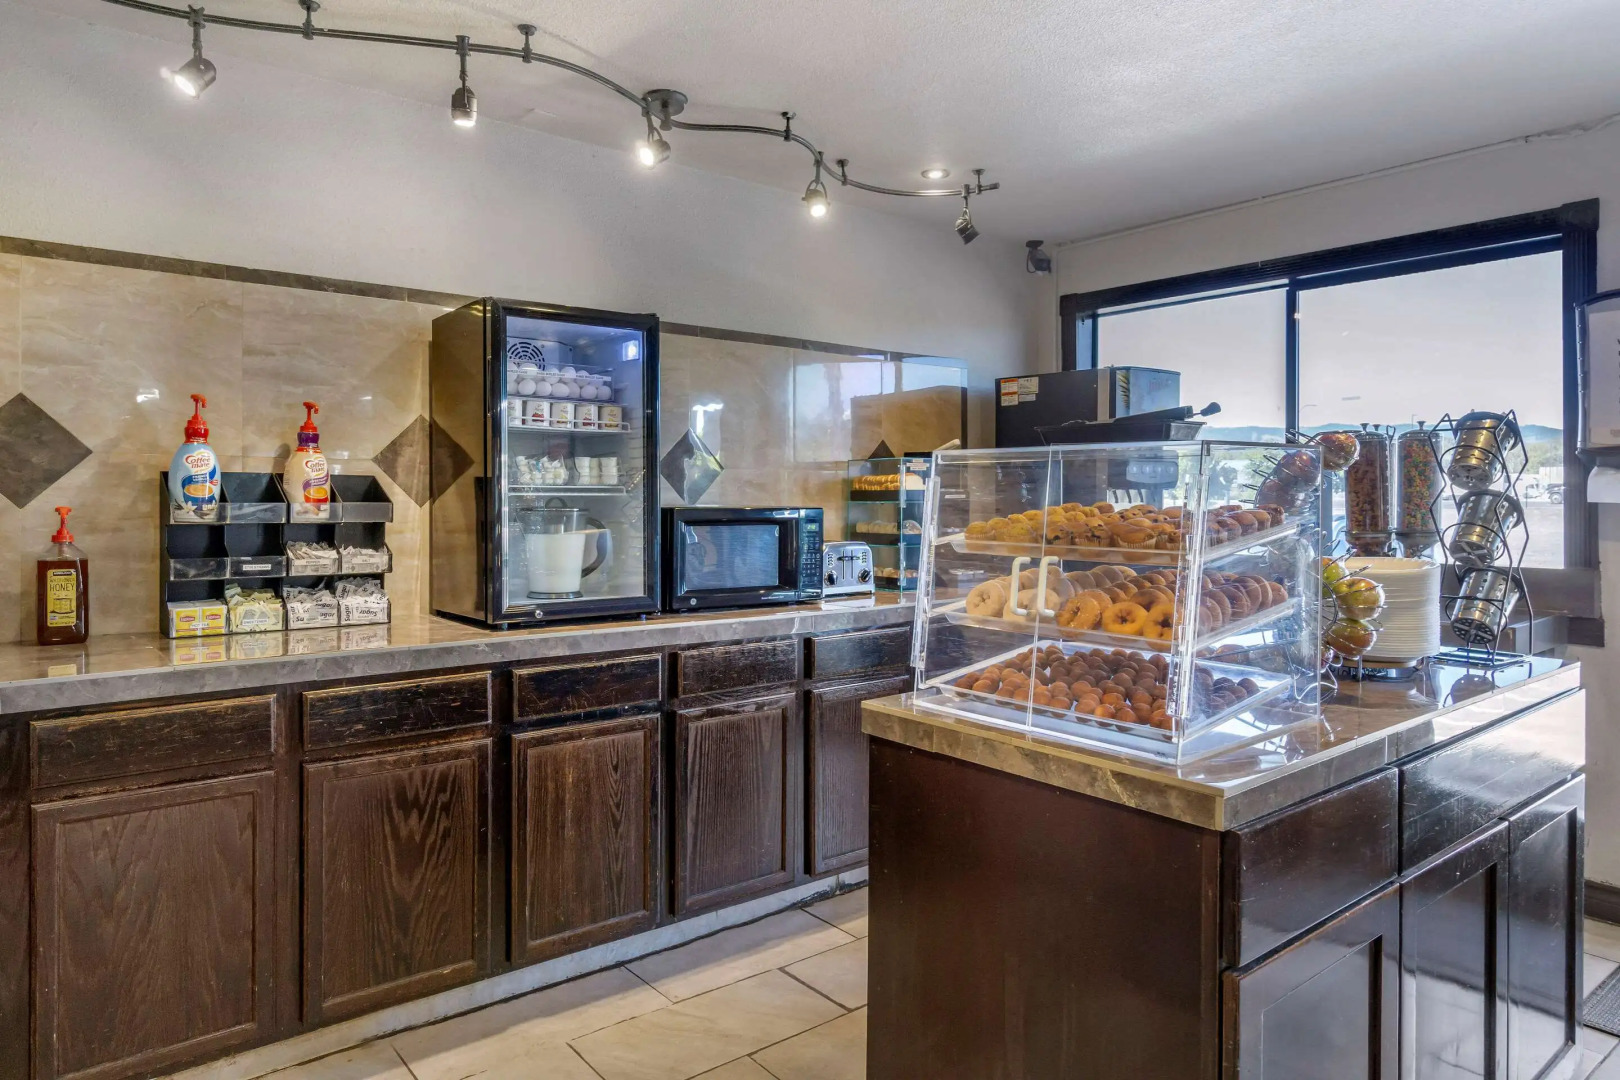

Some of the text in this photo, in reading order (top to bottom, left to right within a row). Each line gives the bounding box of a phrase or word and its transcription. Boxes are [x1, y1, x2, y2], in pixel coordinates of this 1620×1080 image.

[185, 455, 210, 464] Coffee
[305, 461, 325, 469] Coffee
[50, 583, 75, 592] HONEY
